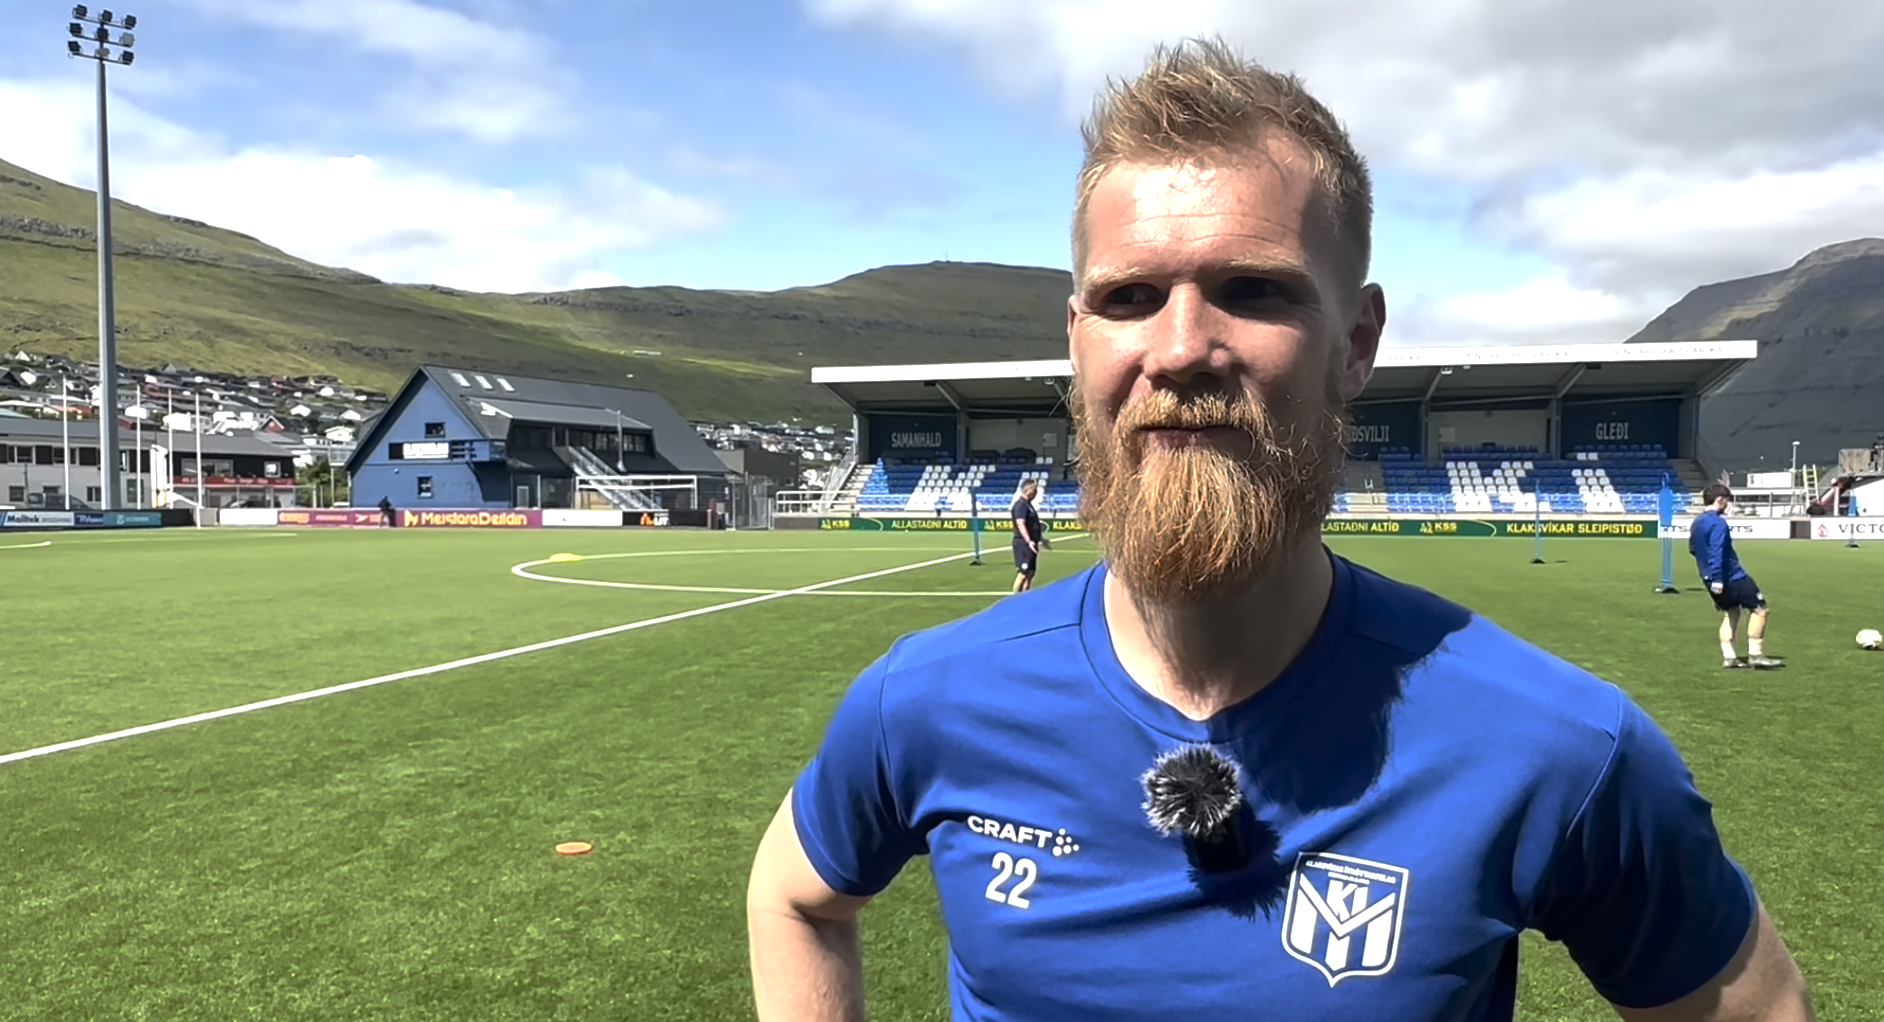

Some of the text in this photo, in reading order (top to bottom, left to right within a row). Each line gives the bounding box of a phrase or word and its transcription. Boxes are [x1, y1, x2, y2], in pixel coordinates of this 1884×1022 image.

[1595, 422, 1629, 440] GLEÐI
[891, 432, 942, 447] SAMANHALD
[832, 520, 850, 528] KSS
[1321, 522, 1368, 531] LASTAÐNI
[1434, 522, 1457, 533] KSS
[967, 815, 1053, 848] CRAFT
[985, 852, 1037, 909] 22
